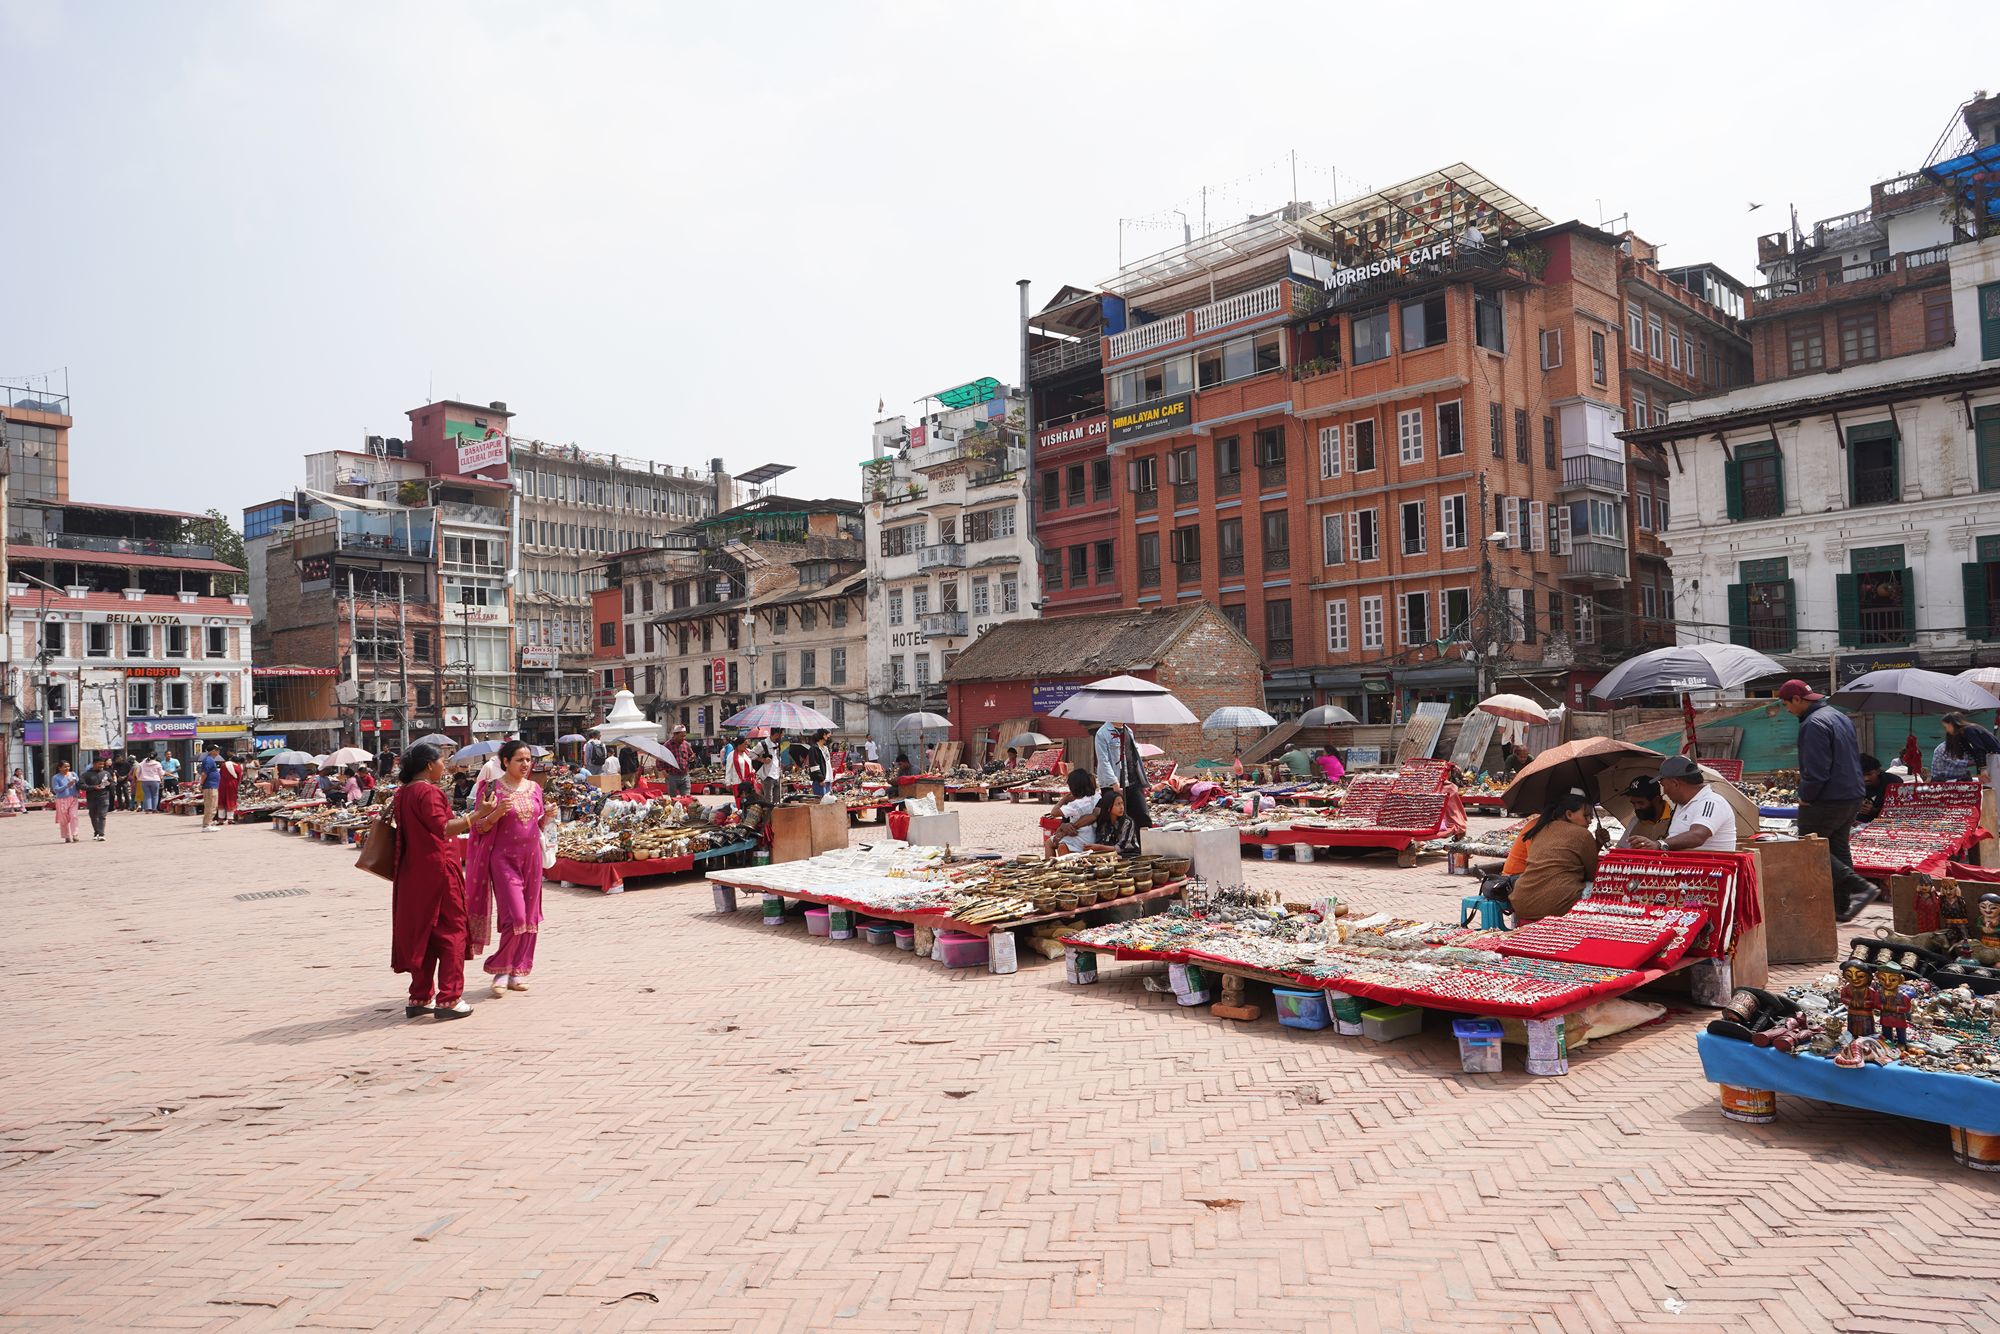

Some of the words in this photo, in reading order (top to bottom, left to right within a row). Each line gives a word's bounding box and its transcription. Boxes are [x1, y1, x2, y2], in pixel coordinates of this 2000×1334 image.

[1324, 255, 1401, 291] MORRISON
[1409, 240, 1452, 265] CAFE
[1112, 407, 1160, 429] HIMALAYAN
[1161, 401, 1185, 416] CAFE
[1040, 427, 1084, 447] VISHRAM
[1088, 421, 1107, 435] CAF
[464, 440, 502, 456] BASANTAPUR
[460, 452, 486, 466] CULTURAL
[106, 613, 143, 624] BELLA
[148, 615, 181, 625] VISTA
[892, 631, 928, 648] HOTEL
[146, 668, 179, 677] GUSTO
[1688, 676, 1707, 685] Blue
[154, 722, 196, 731] ROBBINS
